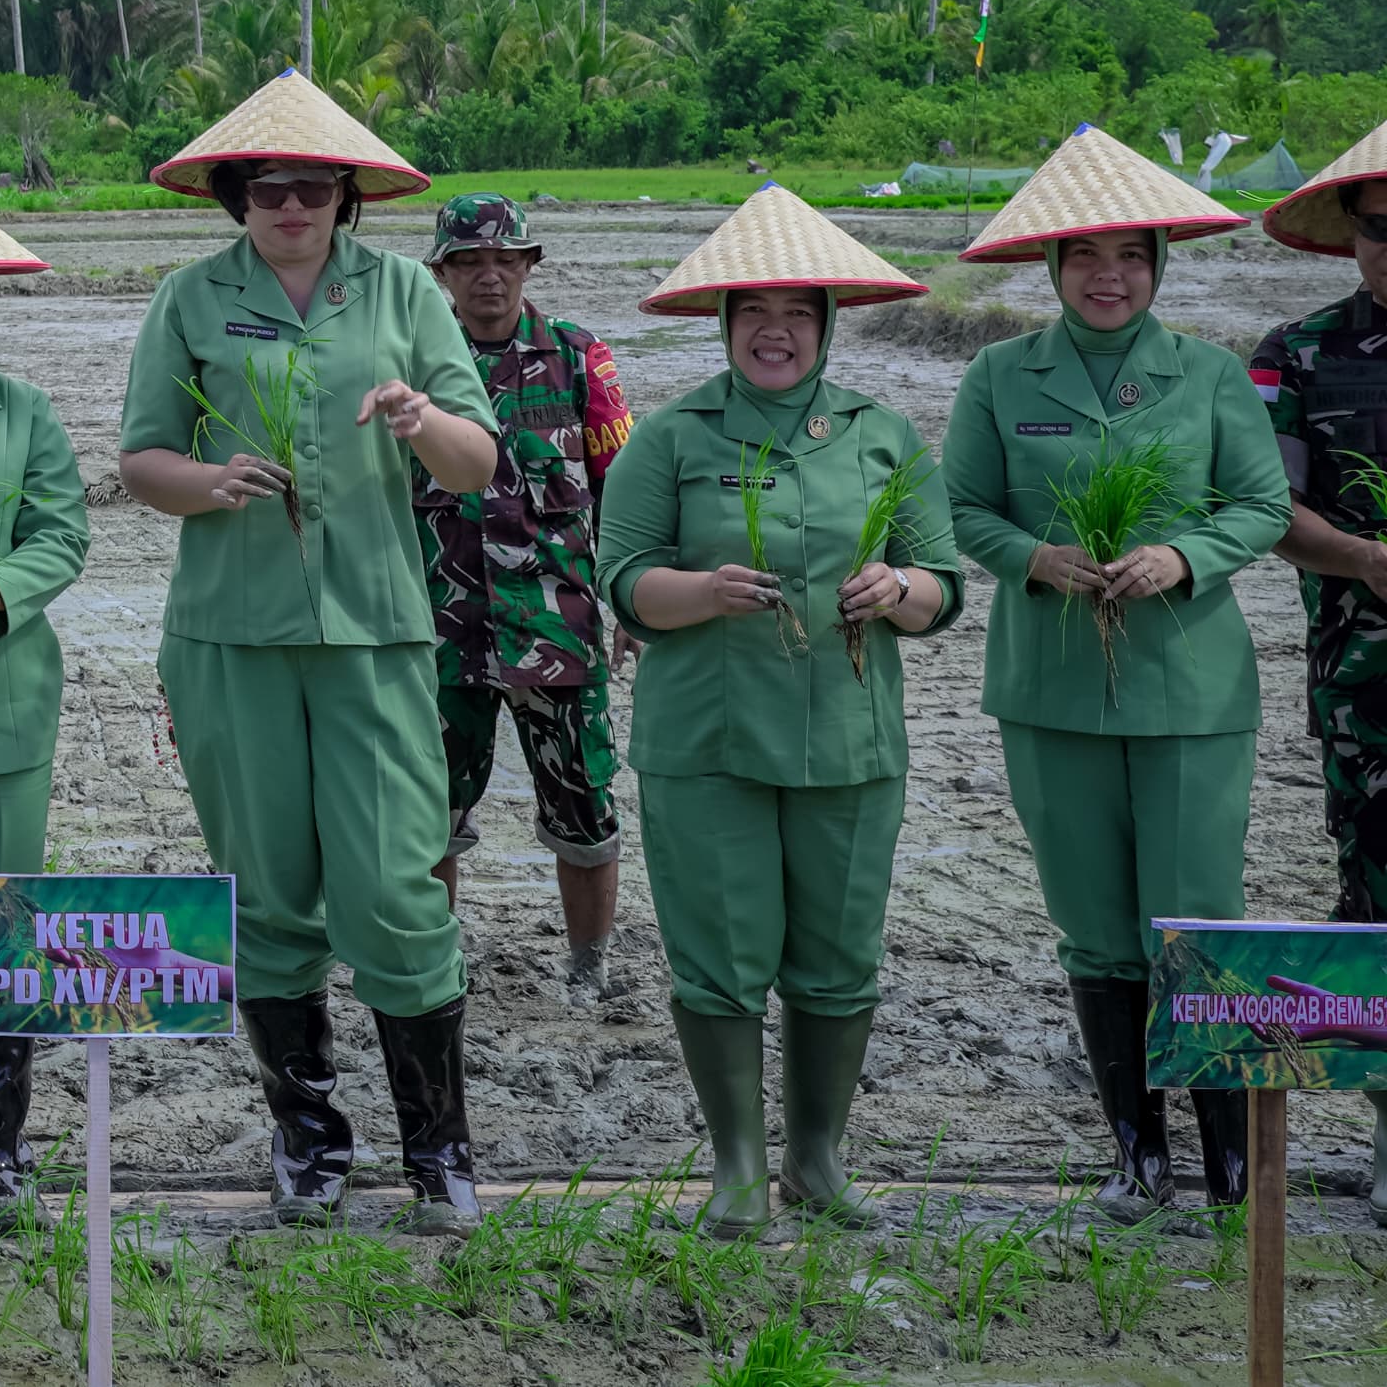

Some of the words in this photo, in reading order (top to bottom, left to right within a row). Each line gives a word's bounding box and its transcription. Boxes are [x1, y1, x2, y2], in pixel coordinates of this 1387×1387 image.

[35, 912, 170, 950] KETUA
[52, 967, 219, 1005] XV/PTM
[1172, 994, 1230, 1023] KETUA
[1234, 995, 1321, 1025] KOORCAB
[1324, 996, 1363, 1025] REM
